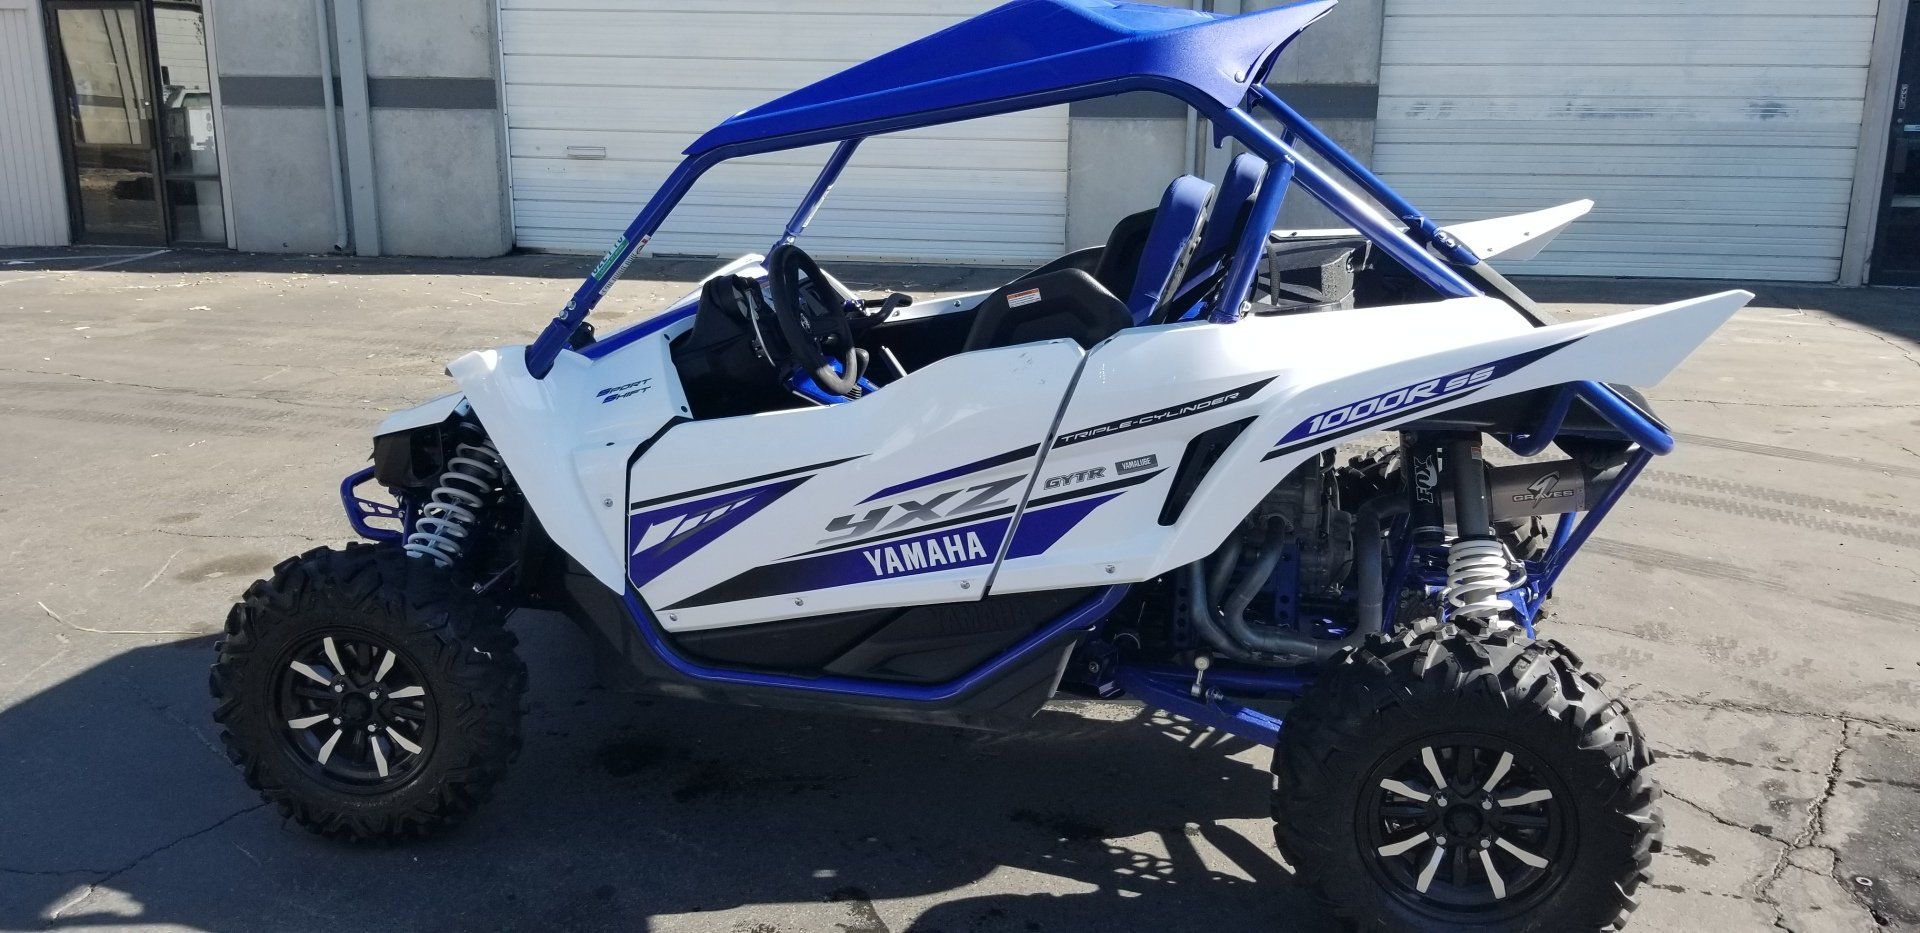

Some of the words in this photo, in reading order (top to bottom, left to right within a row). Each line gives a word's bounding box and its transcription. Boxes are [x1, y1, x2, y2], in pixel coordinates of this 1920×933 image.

[596, 377, 652, 398] SPORT
[602, 386, 652, 404] SHIFT
[1308, 378, 1441, 434] 1000R
[1444, 366, 1496, 392] SS
[1061, 392, 1240, 442] TRIPLE-CYLINDER
[1043, 466, 1107, 490] GYTR
[1121, 457, 1152, 470] YAMALUBE
[1413, 455, 1438, 504] FOX
[815, 473, 1029, 545] YXZ
[1512, 489, 1575, 503] GRAVES
[863, 531, 987, 576] YAMAHA
